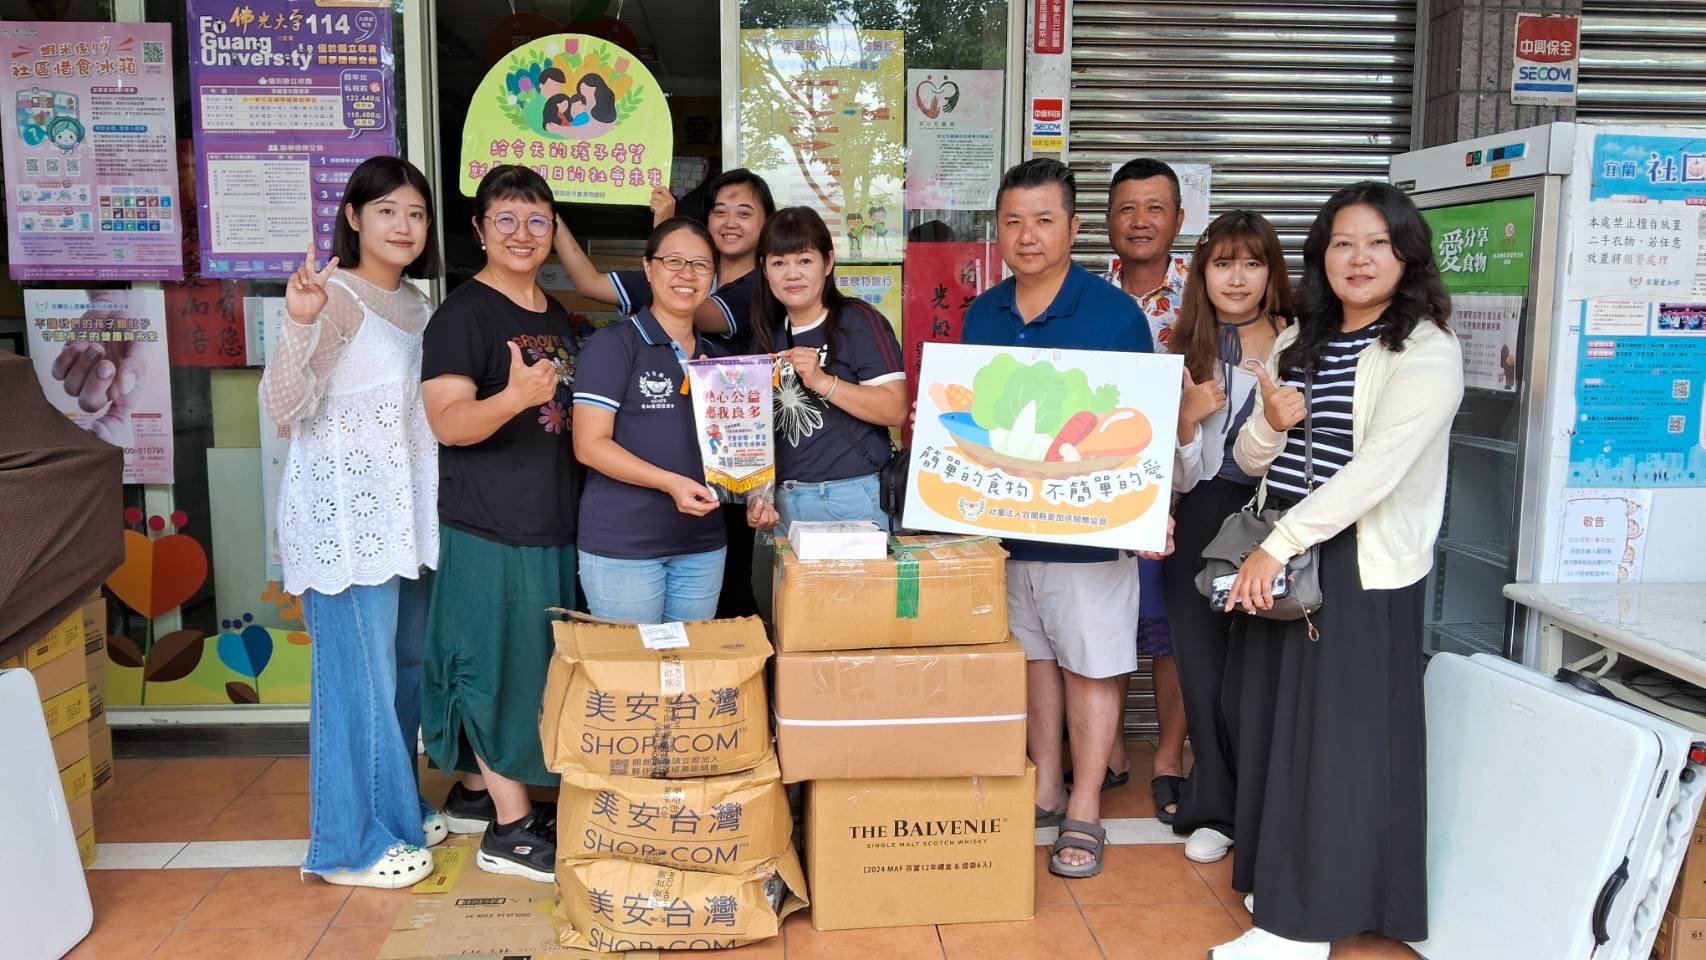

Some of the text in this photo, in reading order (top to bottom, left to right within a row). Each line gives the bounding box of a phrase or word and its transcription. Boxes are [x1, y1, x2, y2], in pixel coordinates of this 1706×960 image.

[231, 6, 303, 34] 佛光大學
[306, 13, 350, 35] 114
[201, 32, 272, 54] Guang
[1520, 39, 1572, 56] 中興保全
[11, 58, 136, 78] 社區惜食冰箱
[1519, 66, 1571, 81] SECOM
[1034, 123, 1061, 131] SECOM
[490, 139, 645, 164] 給今天的孩子希望
[1604, 161, 1635, 178] 宜蘭
[1589, 216, 1683, 231] 本處禁止擅自放置
[1439, 229, 1464, 272] 愛
[1463, 253, 1487, 272] 食物
[919, 445, 1164, 503] 簡單的食物 不簡單的愛
[585, 687, 741, 722] 美安台灣
[592, 790, 742, 835] 美安台灣
[849, 818, 1001, 839] THE BALVENIE
[887, 865, 903, 873] MAF
[588, 888, 738, 928] 美安台灣
